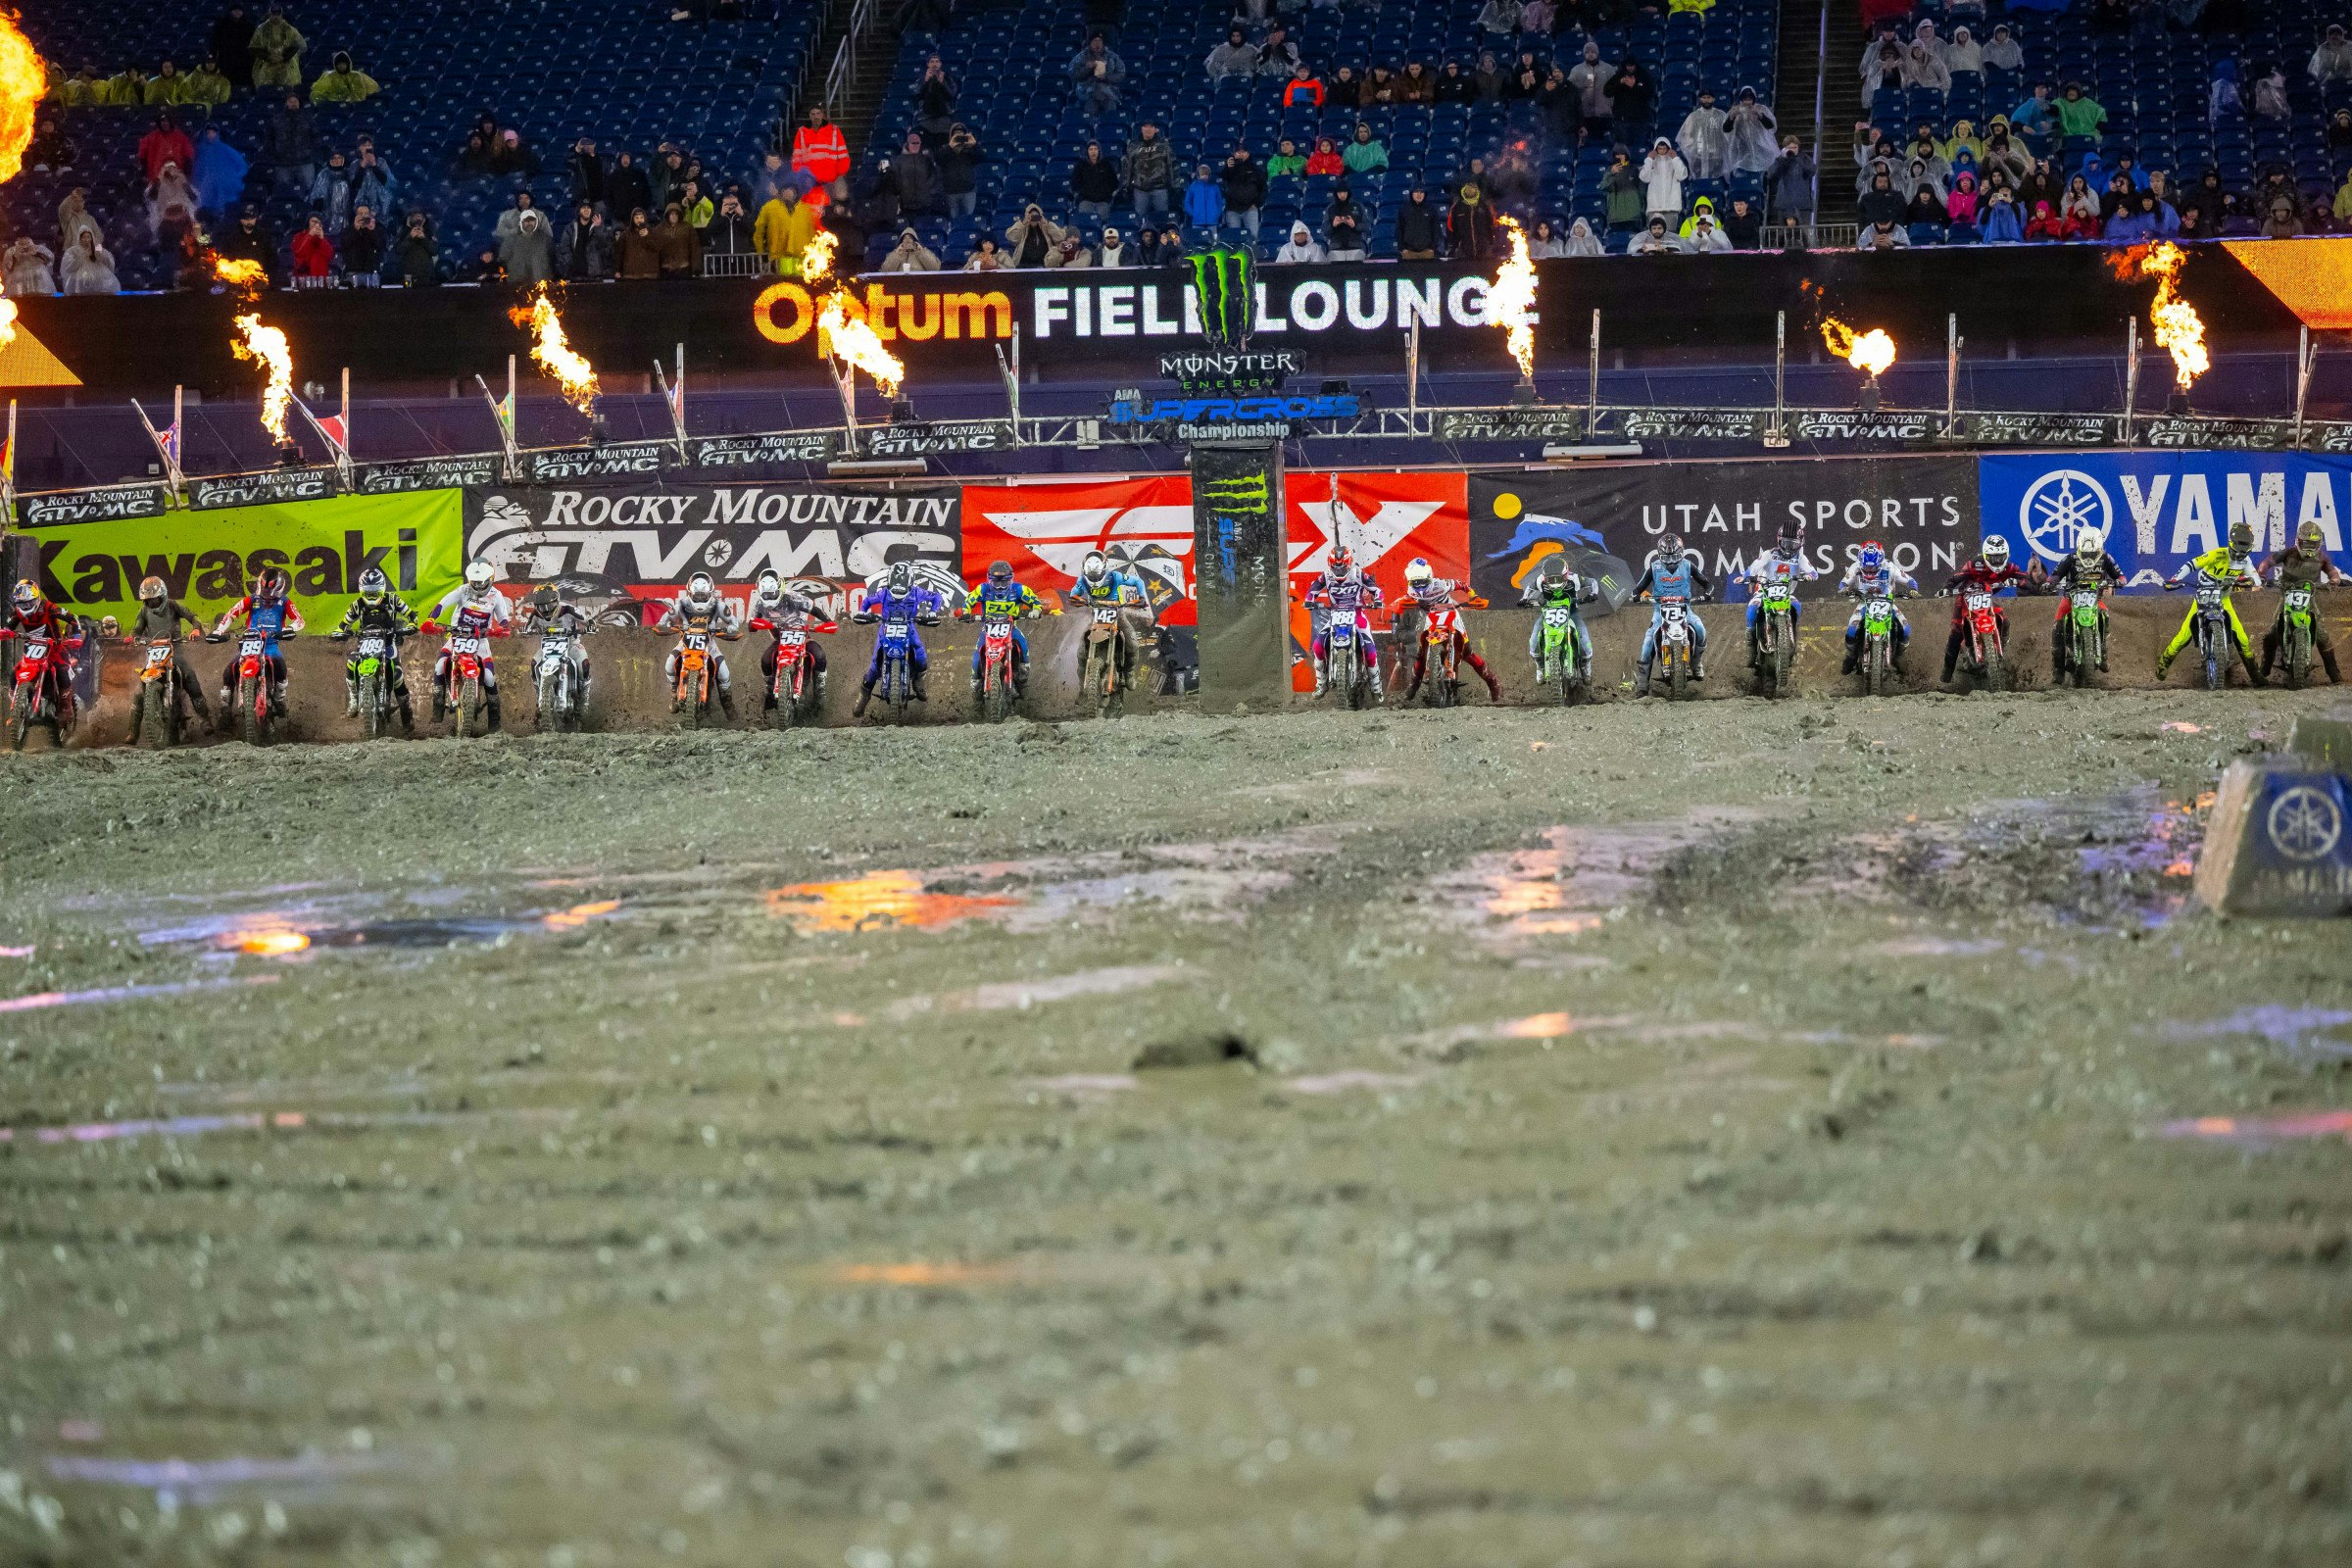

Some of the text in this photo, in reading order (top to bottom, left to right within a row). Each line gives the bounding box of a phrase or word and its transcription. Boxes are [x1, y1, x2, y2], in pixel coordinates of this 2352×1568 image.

[1161, 353, 1296, 377] MONSTER
[1183, 378, 1276, 390] ENERGY
[1114, 388, 1142, 400] AMA
[1107, 395, 1360, 422] SUPERCROSS
[1178, 422, 1291, 440] Championship
[542, 489, 956, 526] ROCKY MOUNTAIN
[1642, 496, 1960, 534] UTAH SPORTS
[2119, 471, 2352, 555] YAMA
[39, 528, 417, 605] Kawasaki
[1767, 585, 1788, 598] 192
[1967, 594, 1991, 611] 195
[2074, 592, 2097, 607] 996
[2284, 592, 2311, 607] 437
[1662, 607, 1686, 620] 734
[1869, 601, 1891, 616] 62
[1094, 609, 1117, 624] 142
[1331, 611, 1355, 625] 188
[1435, 611, 1448, 625] 1
[1544, 609, 1568, 624] 56
[885, 624, 908, 638] 92
[986, 623, 1010, 638] 148
[454, 638, 478, 654] 59
[686, 635, 706, 650] 75
[780, 631, 806, 646] 55
[25, 644, 46, 660] 10
[240, 640, 262, 657] 89
[359, 638, 384, 655] 489
[542, 641, 567, 656] 24
[147, 647, 170, 662] 137
